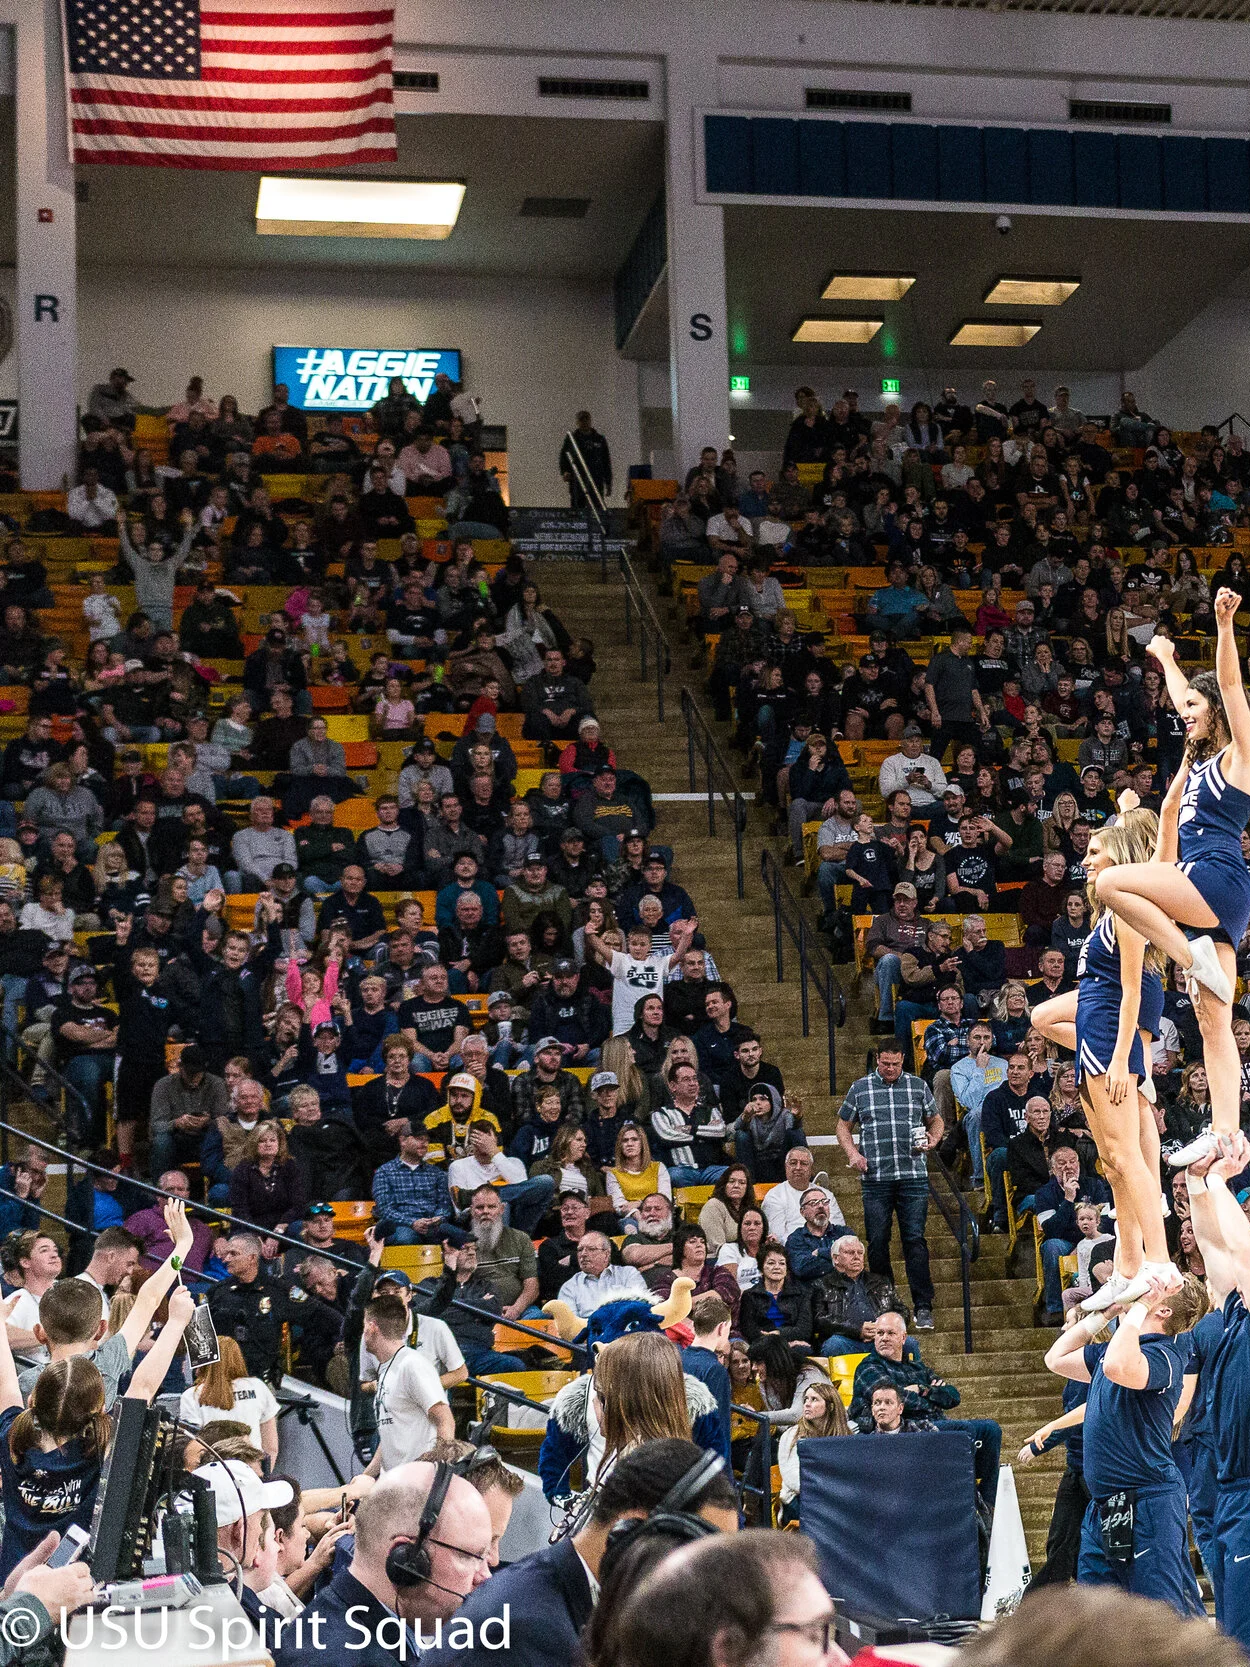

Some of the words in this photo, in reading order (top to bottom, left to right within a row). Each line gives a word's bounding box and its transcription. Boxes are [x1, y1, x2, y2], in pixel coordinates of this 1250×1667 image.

[35, 295, 59, 322] R
[690, 314, 712, 340] S
[297, 350, 441, 382] #AGGIE
[732, 377, 749, 389] EXIT
[883, 379, 899, 391] EXIT
[431, 1017, 457, 1031] WAY
[233, 1389, 257, 1402] TEAM
[18, 1486, 42, 1507] THE
